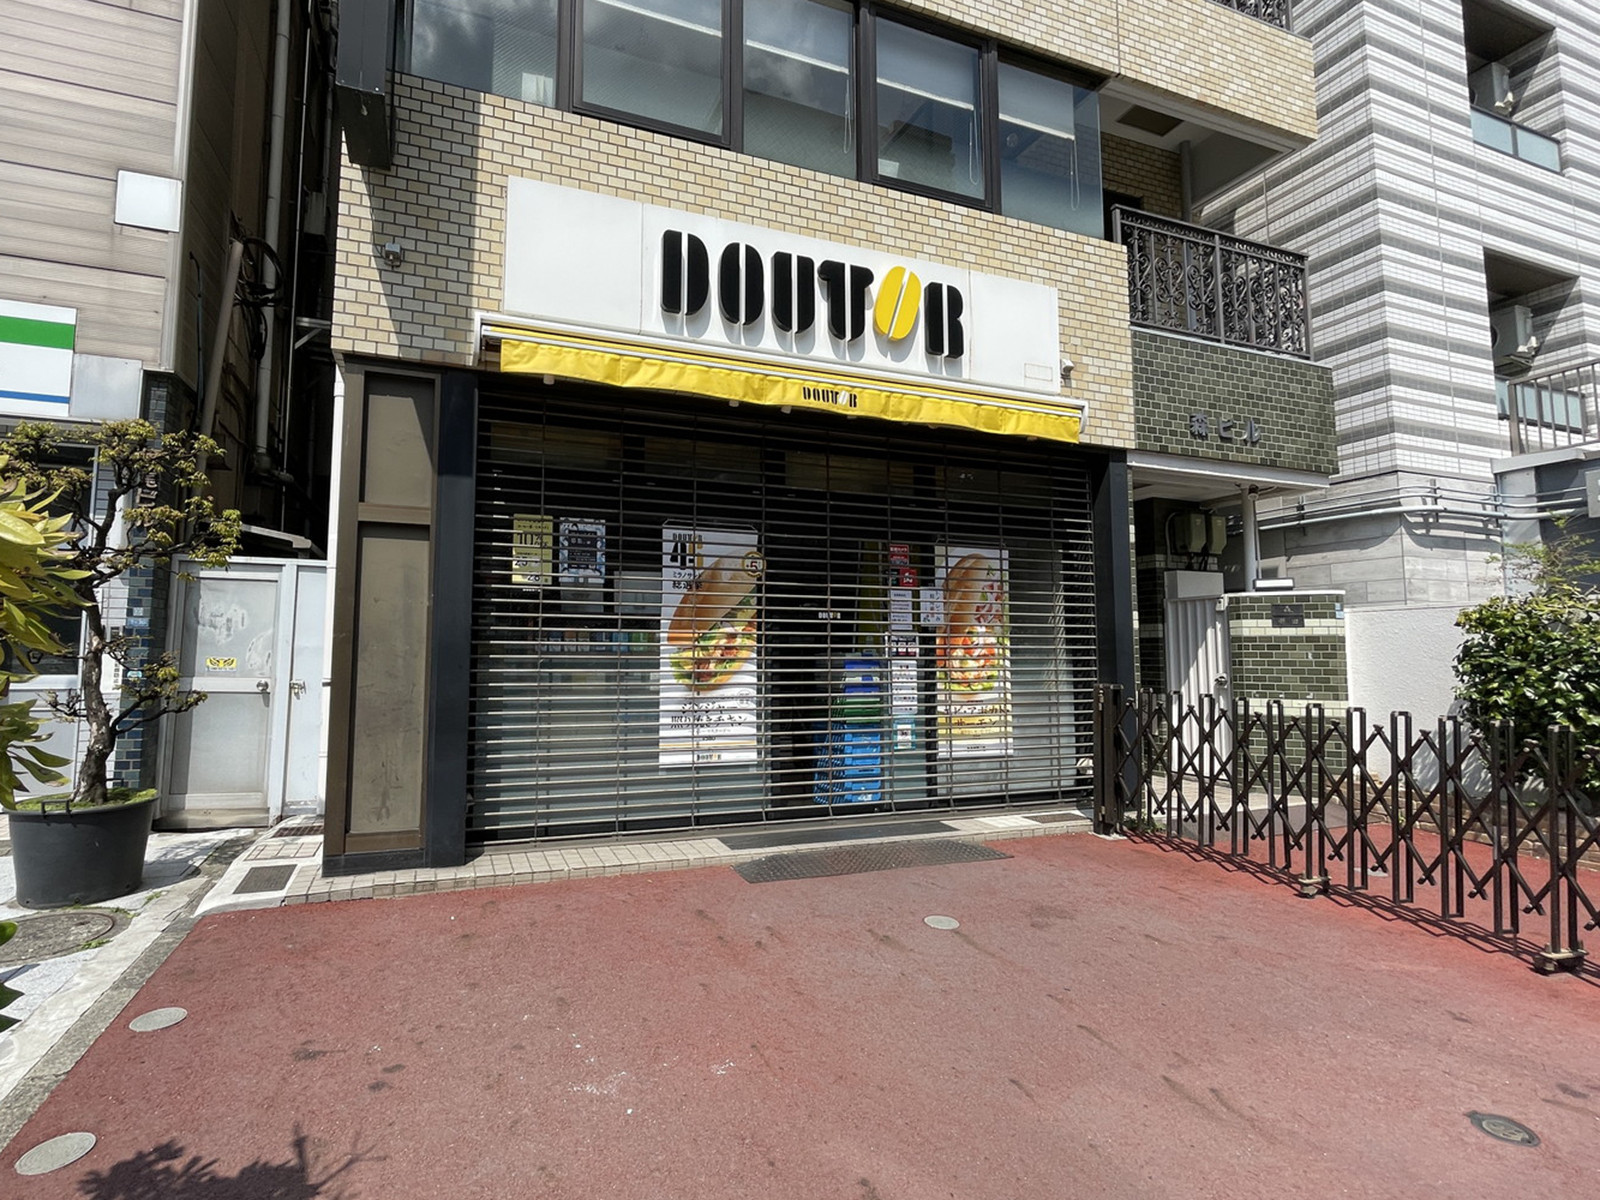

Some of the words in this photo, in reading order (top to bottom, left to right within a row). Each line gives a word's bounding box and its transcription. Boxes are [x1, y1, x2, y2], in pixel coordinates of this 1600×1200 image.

[660, 229, 965, 359] DOUTOR
[802, 386, 858, 408] DOUTOR
[1189, 410, 1261, 444] 森ビル
